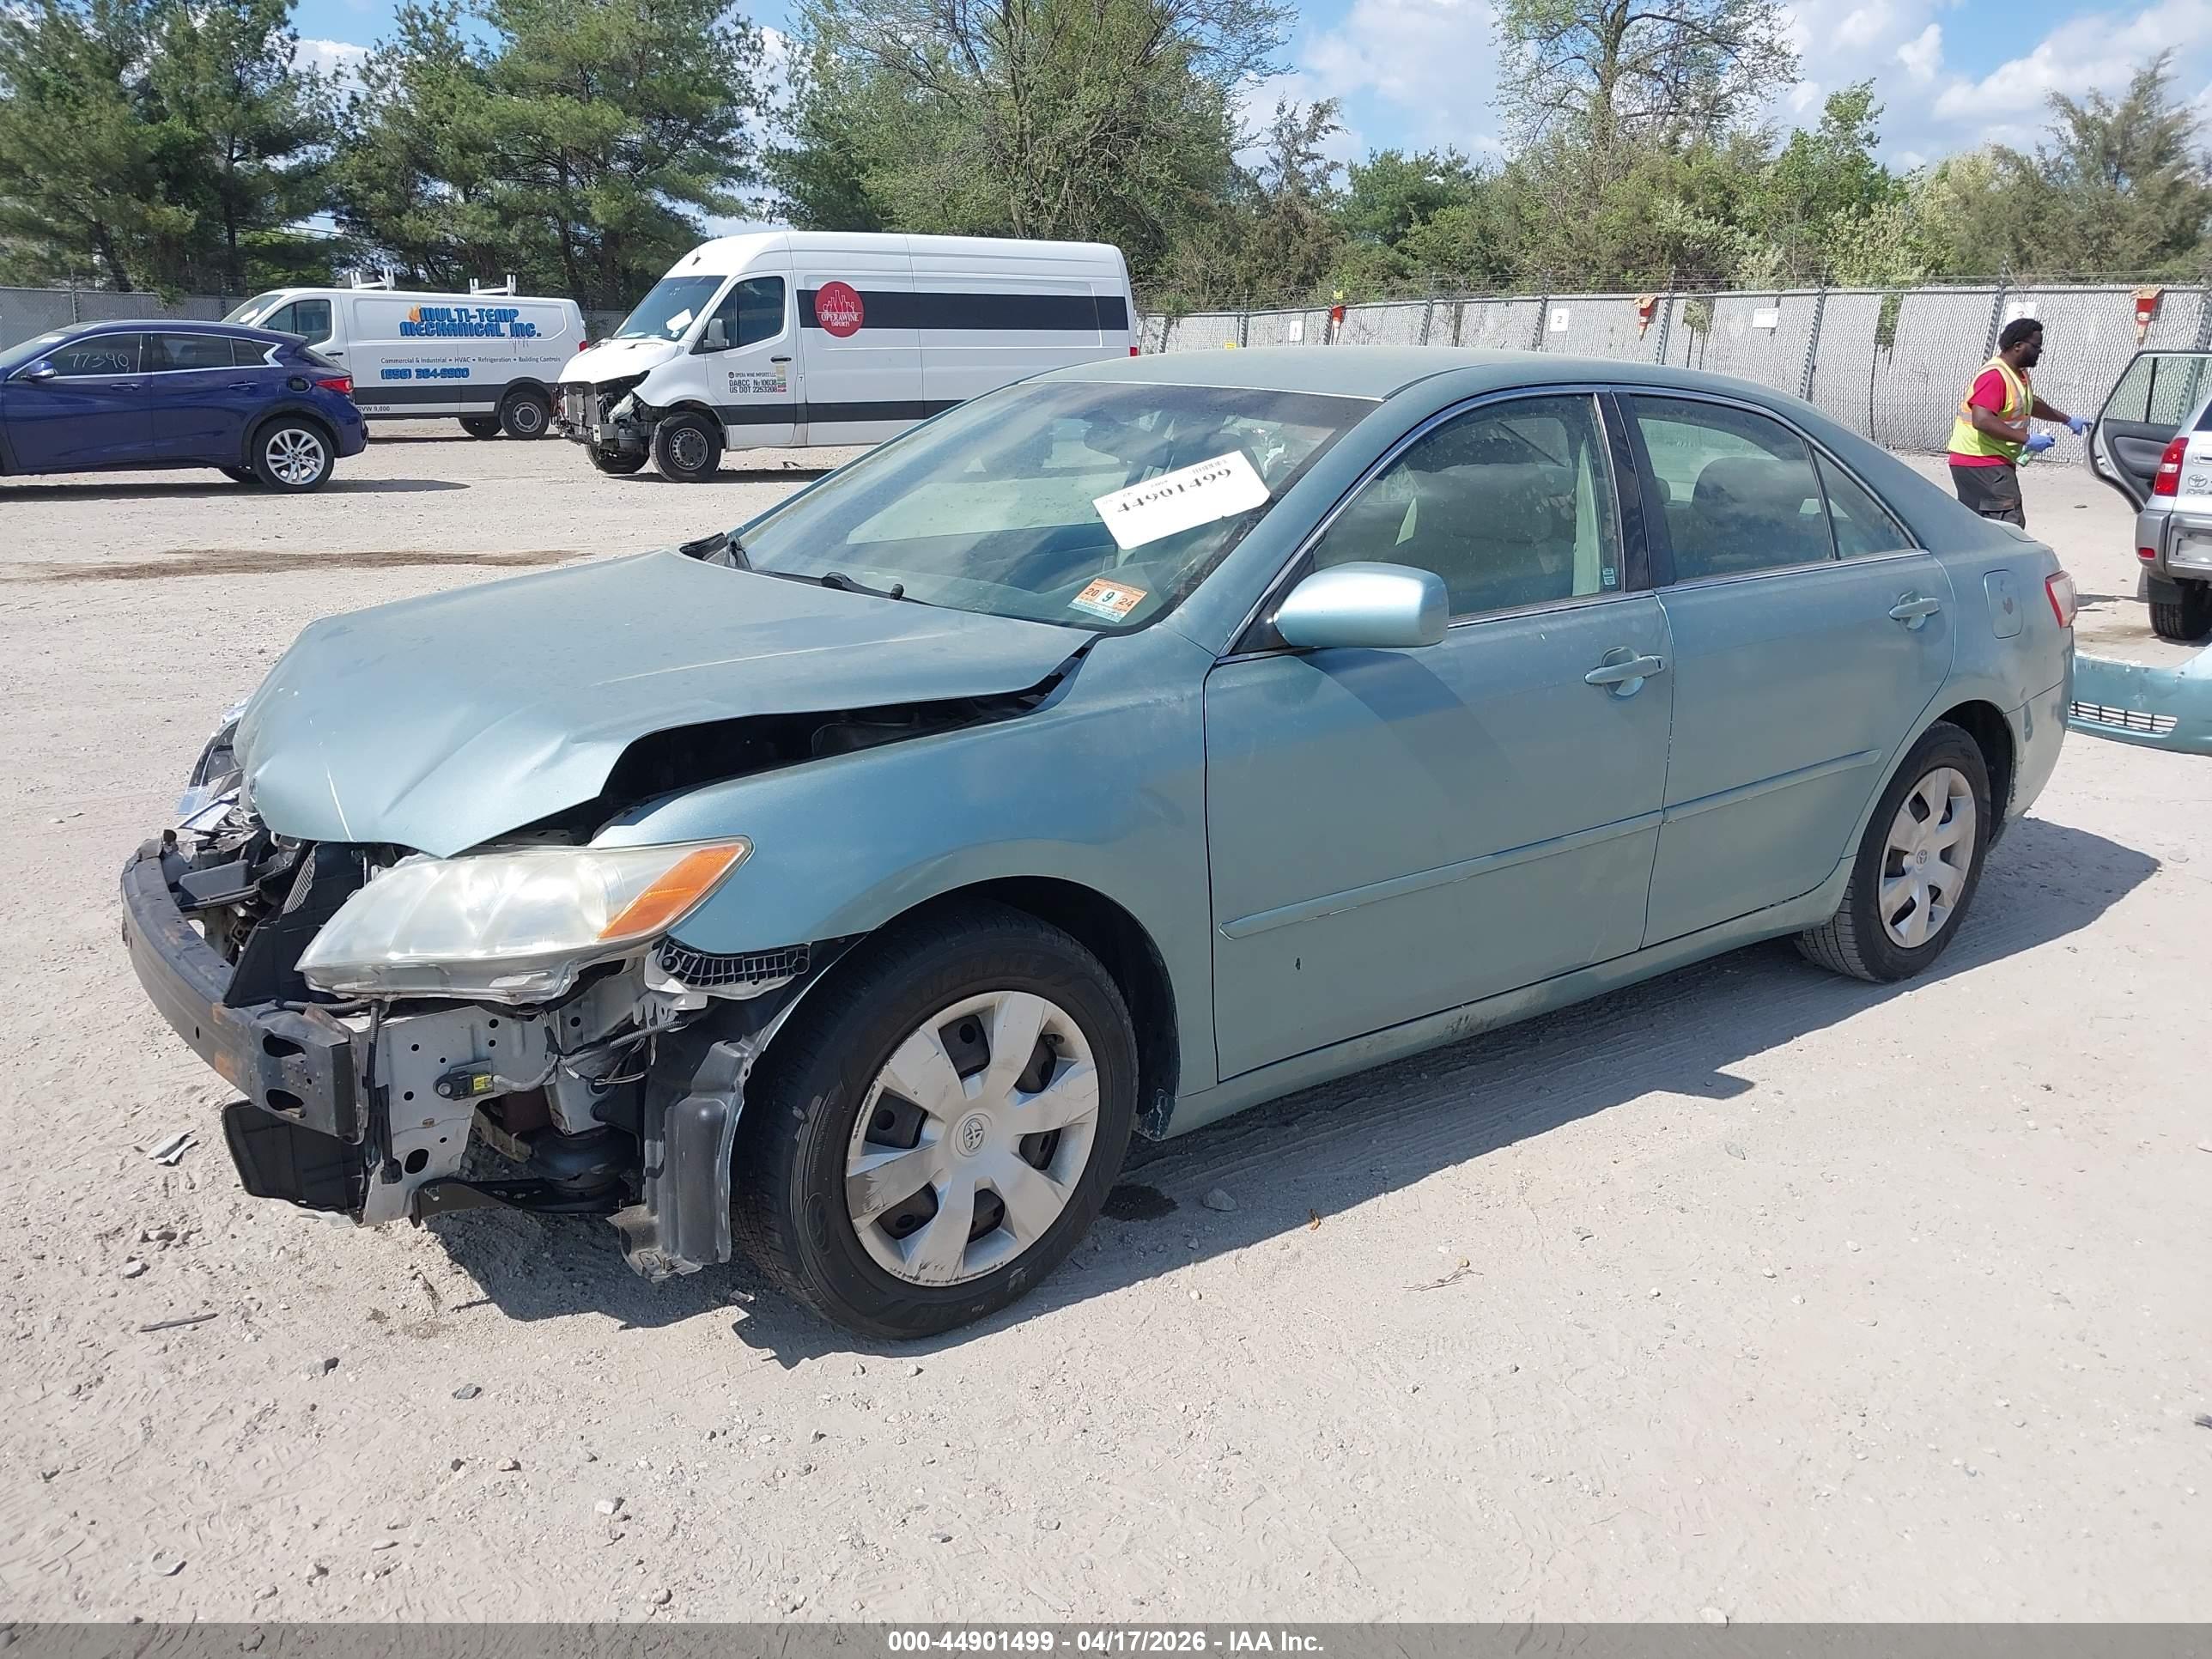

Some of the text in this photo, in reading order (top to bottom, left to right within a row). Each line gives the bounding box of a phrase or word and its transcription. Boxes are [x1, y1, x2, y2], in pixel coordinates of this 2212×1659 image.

[419, 307, 520, 323] MULTI-TEMP
[1557, 315, 1563, 324] 2
[399, 321, 542, 337] MECHANICAL INC.
[518, 356, 539, 364] Building
[1116, 468, 1232, 513] 44901499
[1085, 587, 1100, 597] 20
[1102, 591, 1115, 602] 9
[1118, 598, 1134, 607] 24
